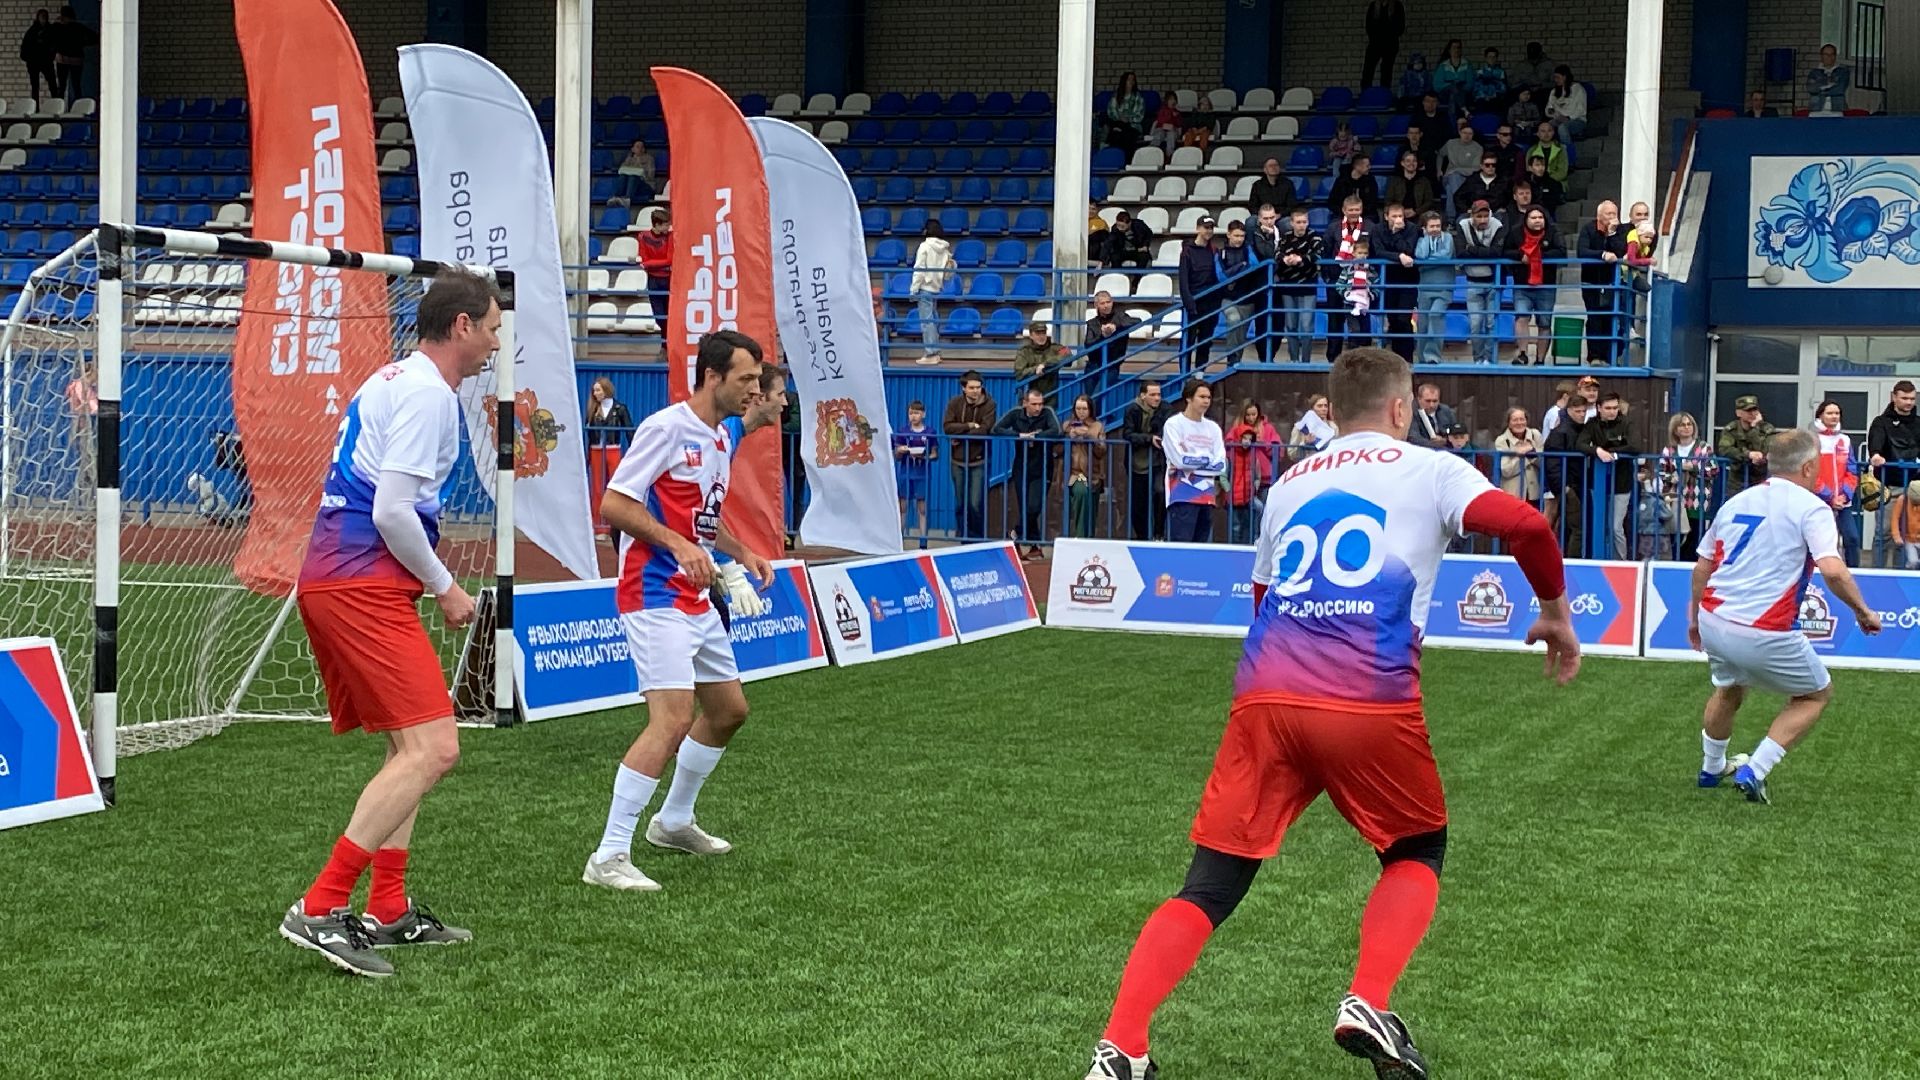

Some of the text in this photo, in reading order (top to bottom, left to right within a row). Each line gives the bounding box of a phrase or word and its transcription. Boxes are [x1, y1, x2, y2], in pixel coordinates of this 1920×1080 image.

[1282, 447, 1403, 484] ШИРКО
[1271, 513, 1386, 597] 20
[1723, 513, 1766, 564] 7
[729, 615, 807, 643] АНДАГУБЕРНАТОРА
[534, 641, 630, 672] #КОМАНДАГУБЕР
